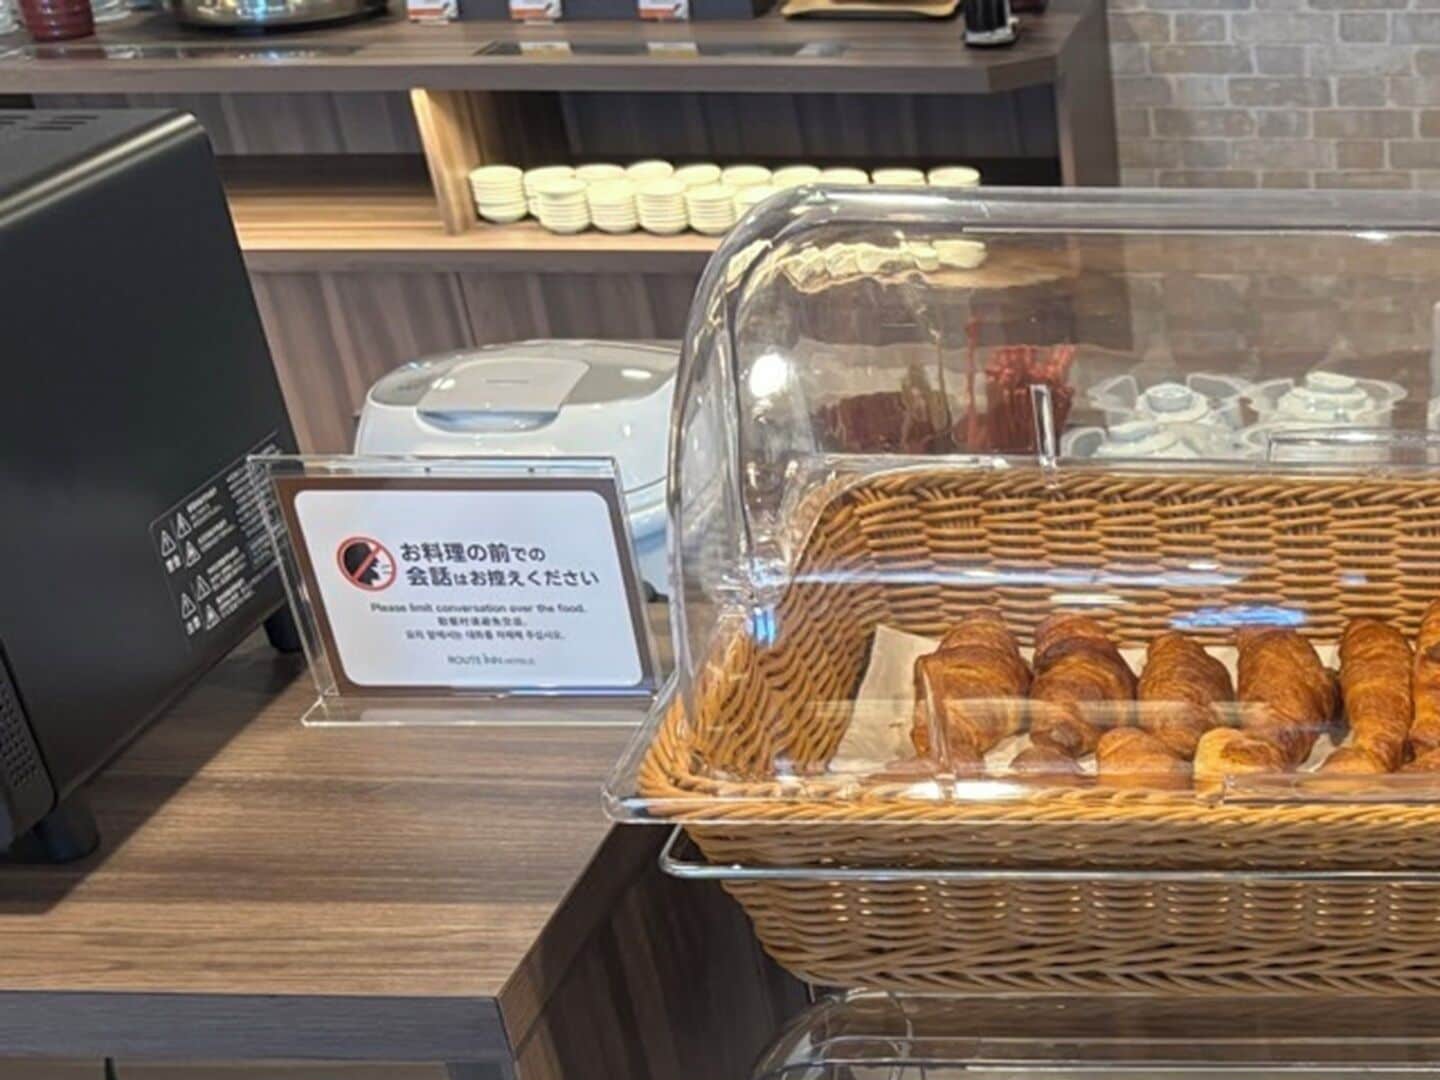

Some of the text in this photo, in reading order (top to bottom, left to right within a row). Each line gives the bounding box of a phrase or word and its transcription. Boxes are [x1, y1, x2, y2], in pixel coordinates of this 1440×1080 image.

[401, 543, 546, 563] お料理の前での
[406, 566, 600, 587] 会話はお控えください
[371, 603, 407, 613] Please
[409, 603, 433, 613] limit
[436, 603, 507, 613] conversation
[510, 604, 533, 613] over
[537, 603, 555, 613] the
